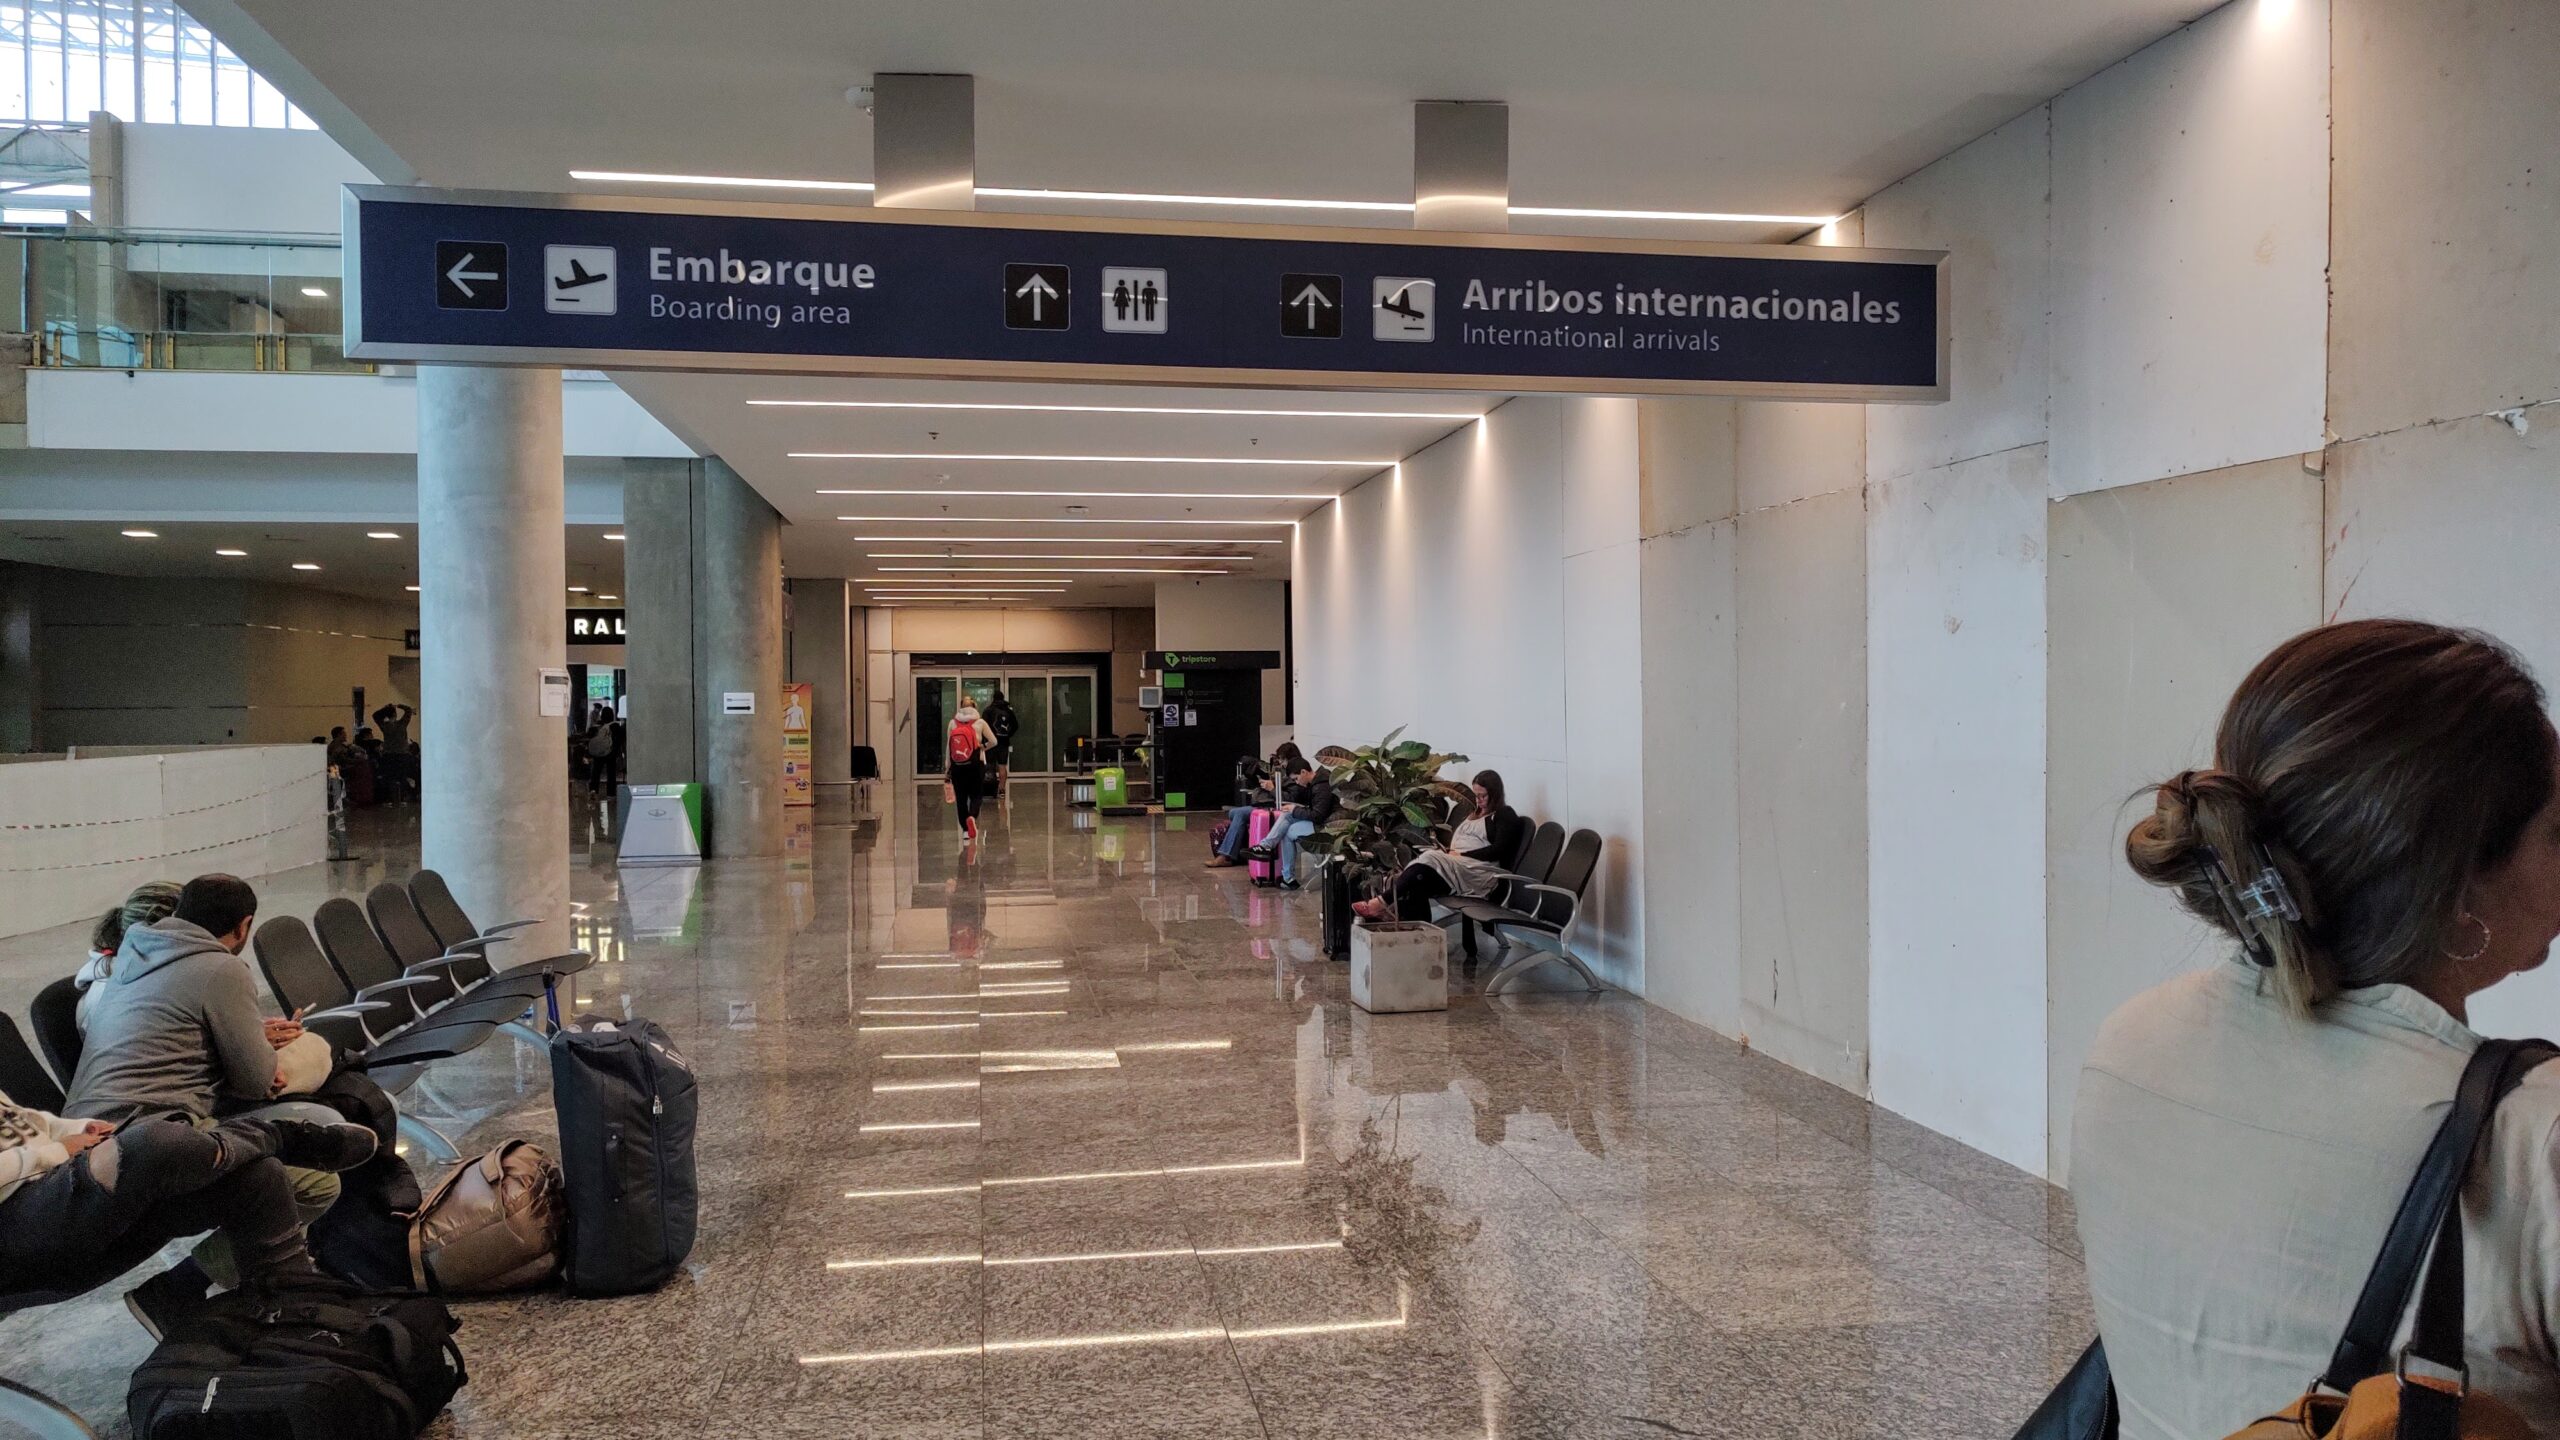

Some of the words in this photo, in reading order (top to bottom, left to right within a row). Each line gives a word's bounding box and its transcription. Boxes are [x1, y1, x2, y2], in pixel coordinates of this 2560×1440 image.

[650, 247, 876, 295] Embarque
[650, 294, 781, 328] Boarding
[791, 305, 850, 324] area
[1462, 279, 1603, 314] Arribos
[1615, 283, 1901, 324] internacionales
[1463, 323, 1624, 350] International
[1633, 328, 1720, 352] arrivals
[1182, 655, 1217, 664] tripstore
